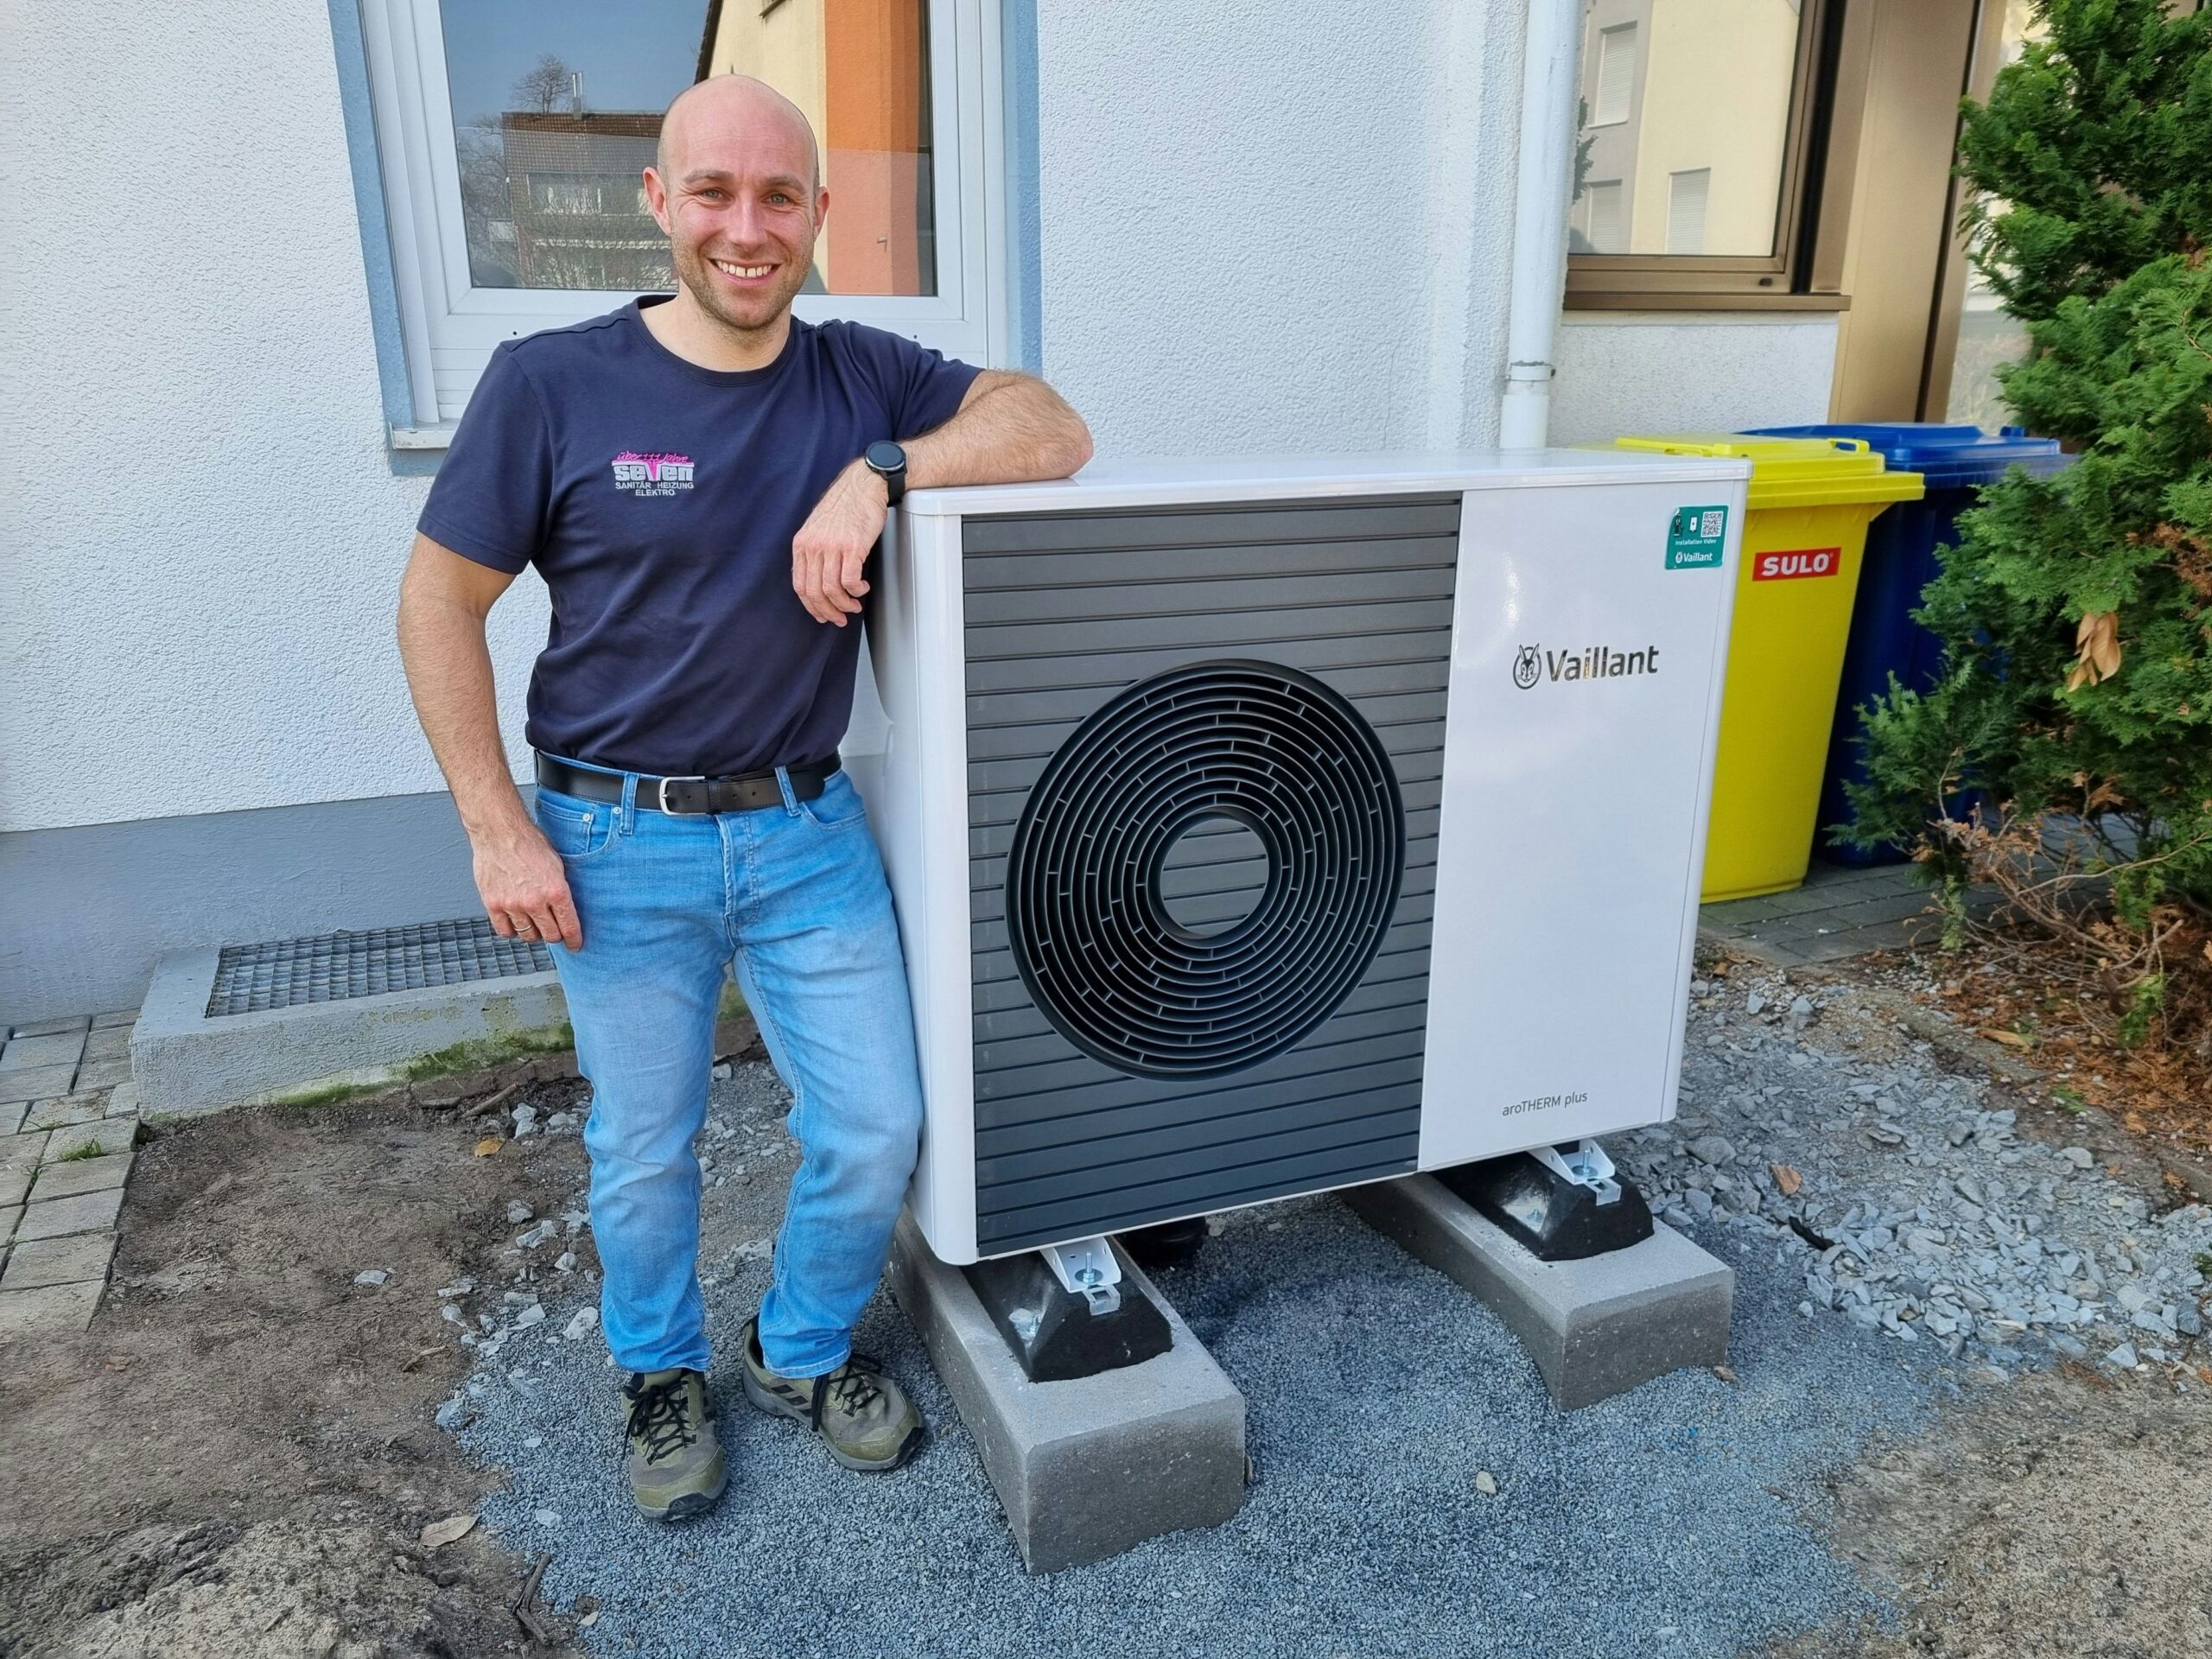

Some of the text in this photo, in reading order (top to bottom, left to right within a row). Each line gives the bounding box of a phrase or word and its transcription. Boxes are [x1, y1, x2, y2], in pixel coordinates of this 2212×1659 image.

[615, 480, 694, 490] SANITÄR HEIZUNG
[635, 488, 677, 497] ELEKTRO
[1683, 552, 1713, 563] Vaillant
[1761, 553, 1829, 576] SULO
[1546, 645, 1660, 683] Vaillant
[1502, 1091, 1588, 1116] aroTHERM plus
